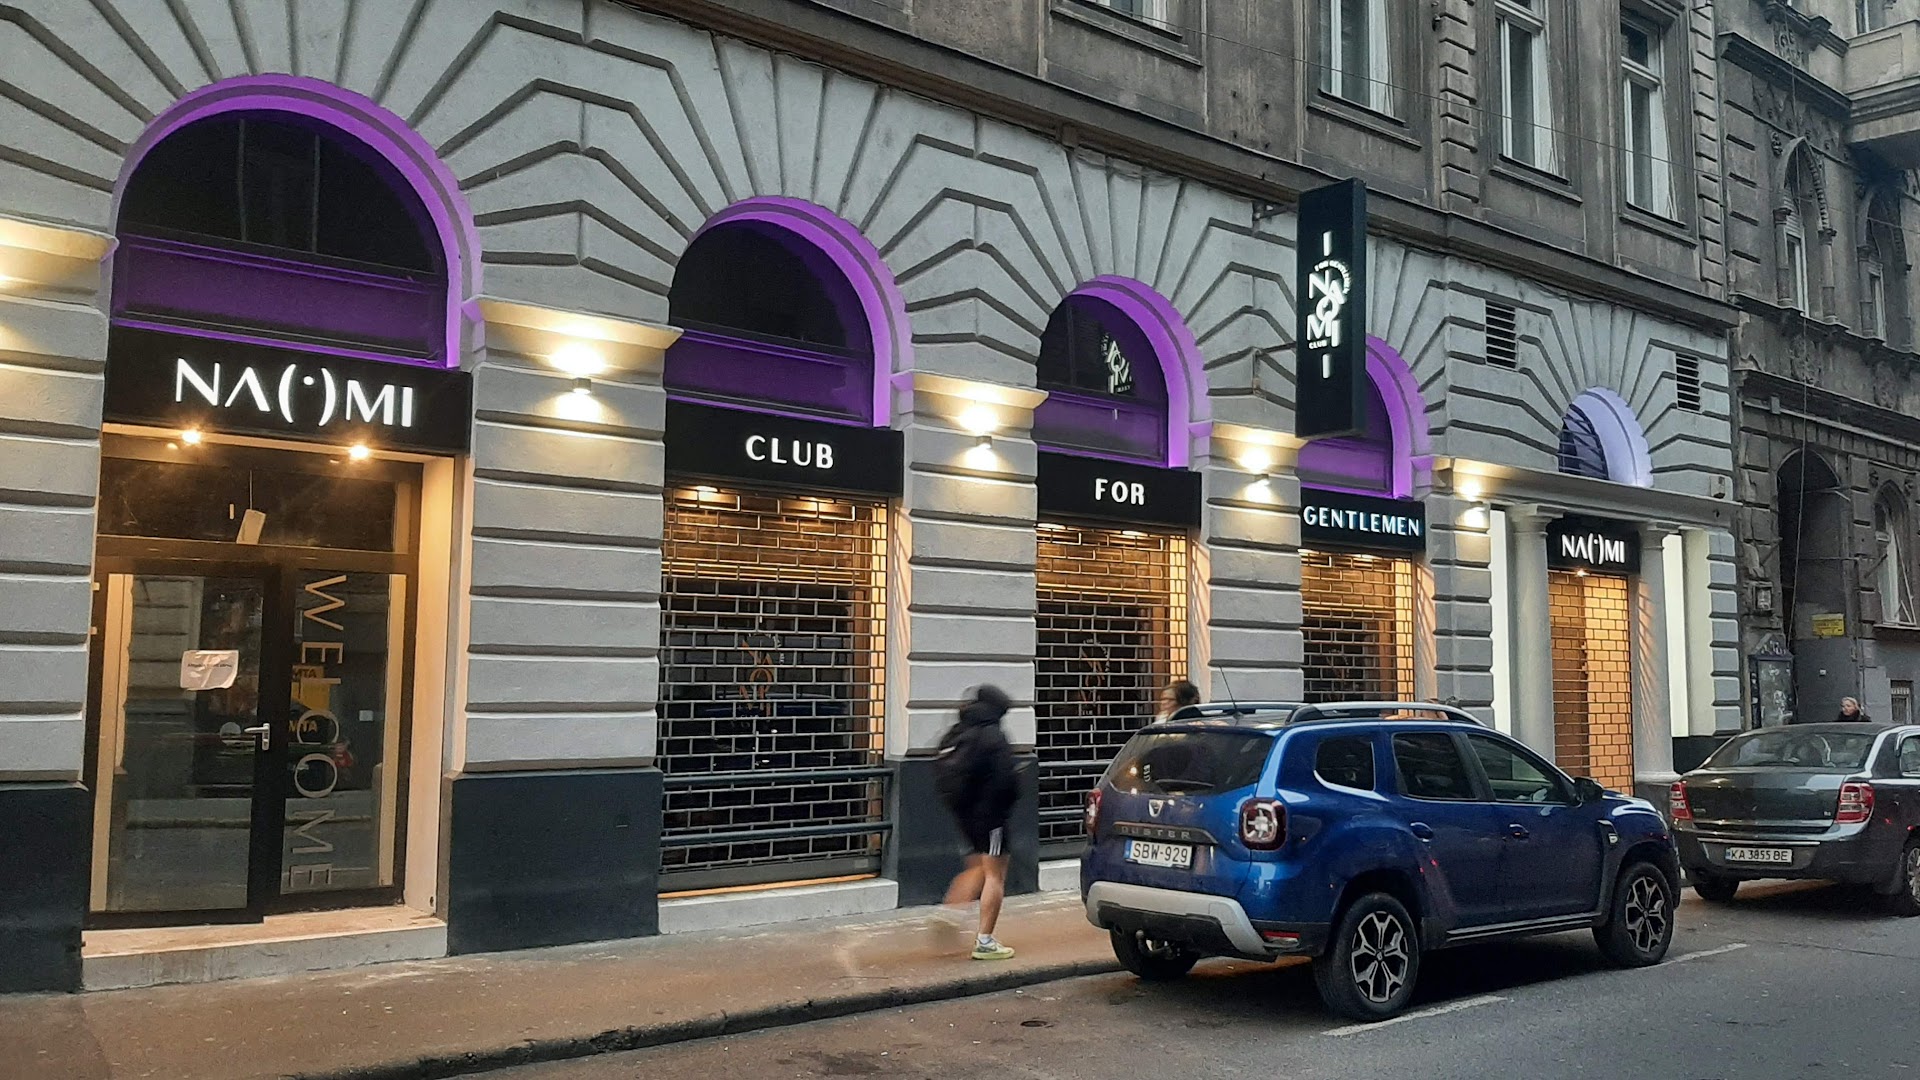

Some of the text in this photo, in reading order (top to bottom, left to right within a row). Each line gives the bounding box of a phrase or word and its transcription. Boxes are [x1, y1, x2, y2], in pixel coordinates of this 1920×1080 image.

[1308, 339, 1328, 349] CLUB
[745, 435, 834, 470] CLUB
[1093, 478, 1146, 505] FOR
[1303, 505, 1420, 537] GENTLEMEN
[289, 575, 347, 888] WELCOME
[1121, 826, 1192, 840] DUSTER
[1132, 843, 1189, 863] SBW-929
[1731, 850, 1789, 861] KA 3855 BE
